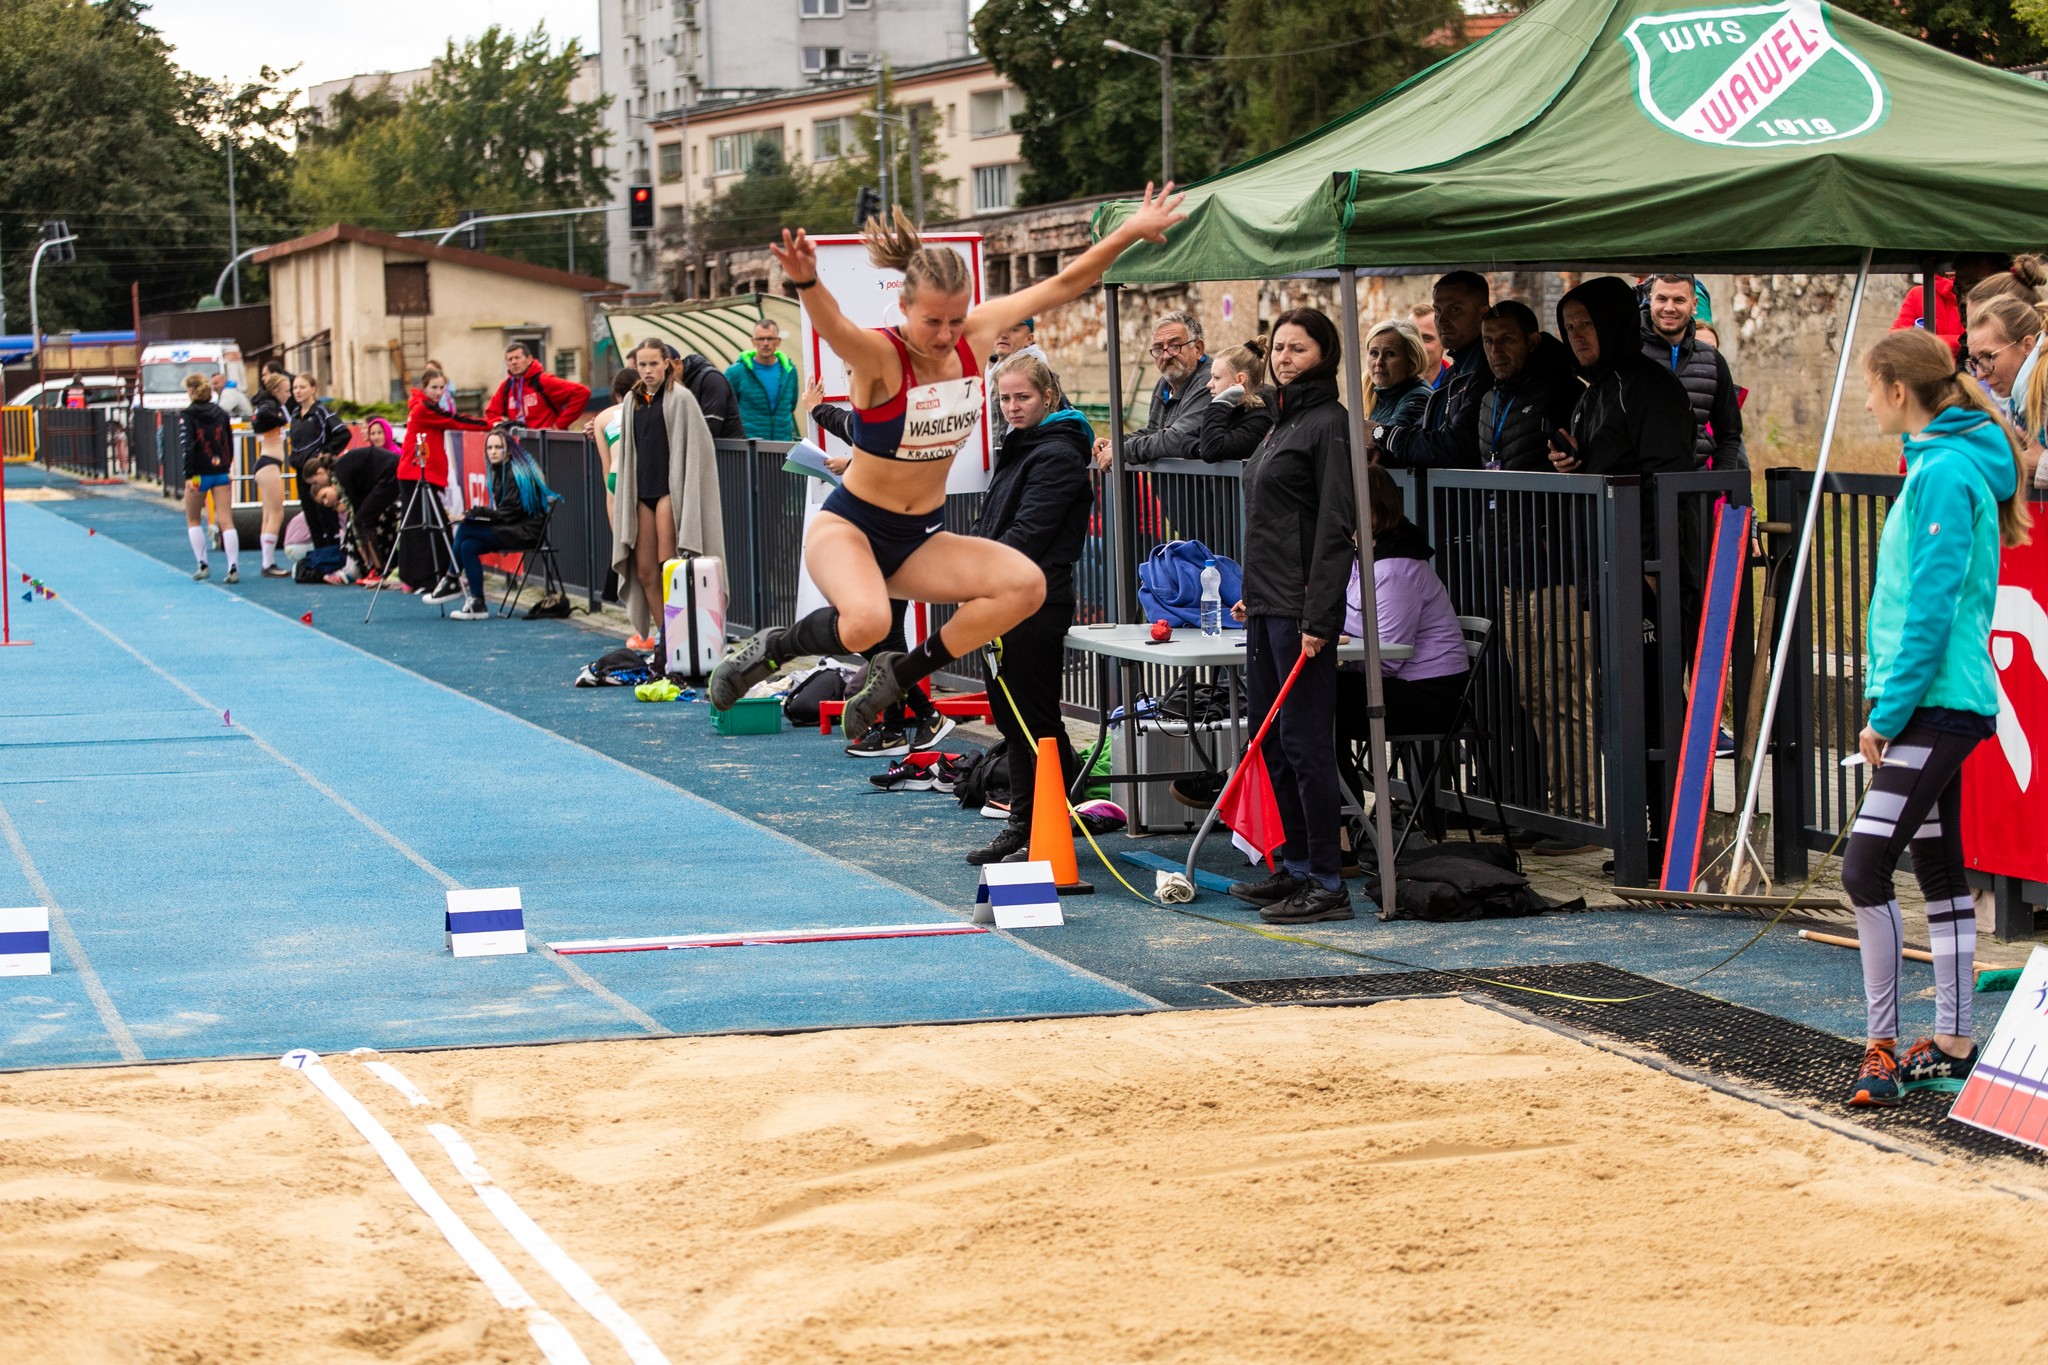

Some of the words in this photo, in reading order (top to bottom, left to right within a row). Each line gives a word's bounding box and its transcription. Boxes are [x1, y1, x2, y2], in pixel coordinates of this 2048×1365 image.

[1658, 20, 1746, 54] WKS
[1699, 18, 1820, 135] WAWEL
[1756, 117, 1837, 137] 1919
[886, 280, 904, 290] pola
[964, 380, 973, 399] 7
[907, 448, 953, 460] KRAKÓW
[292, 1054, 307, 1069] 7
[1910, 1062, 1952, 1080] ナイキ
